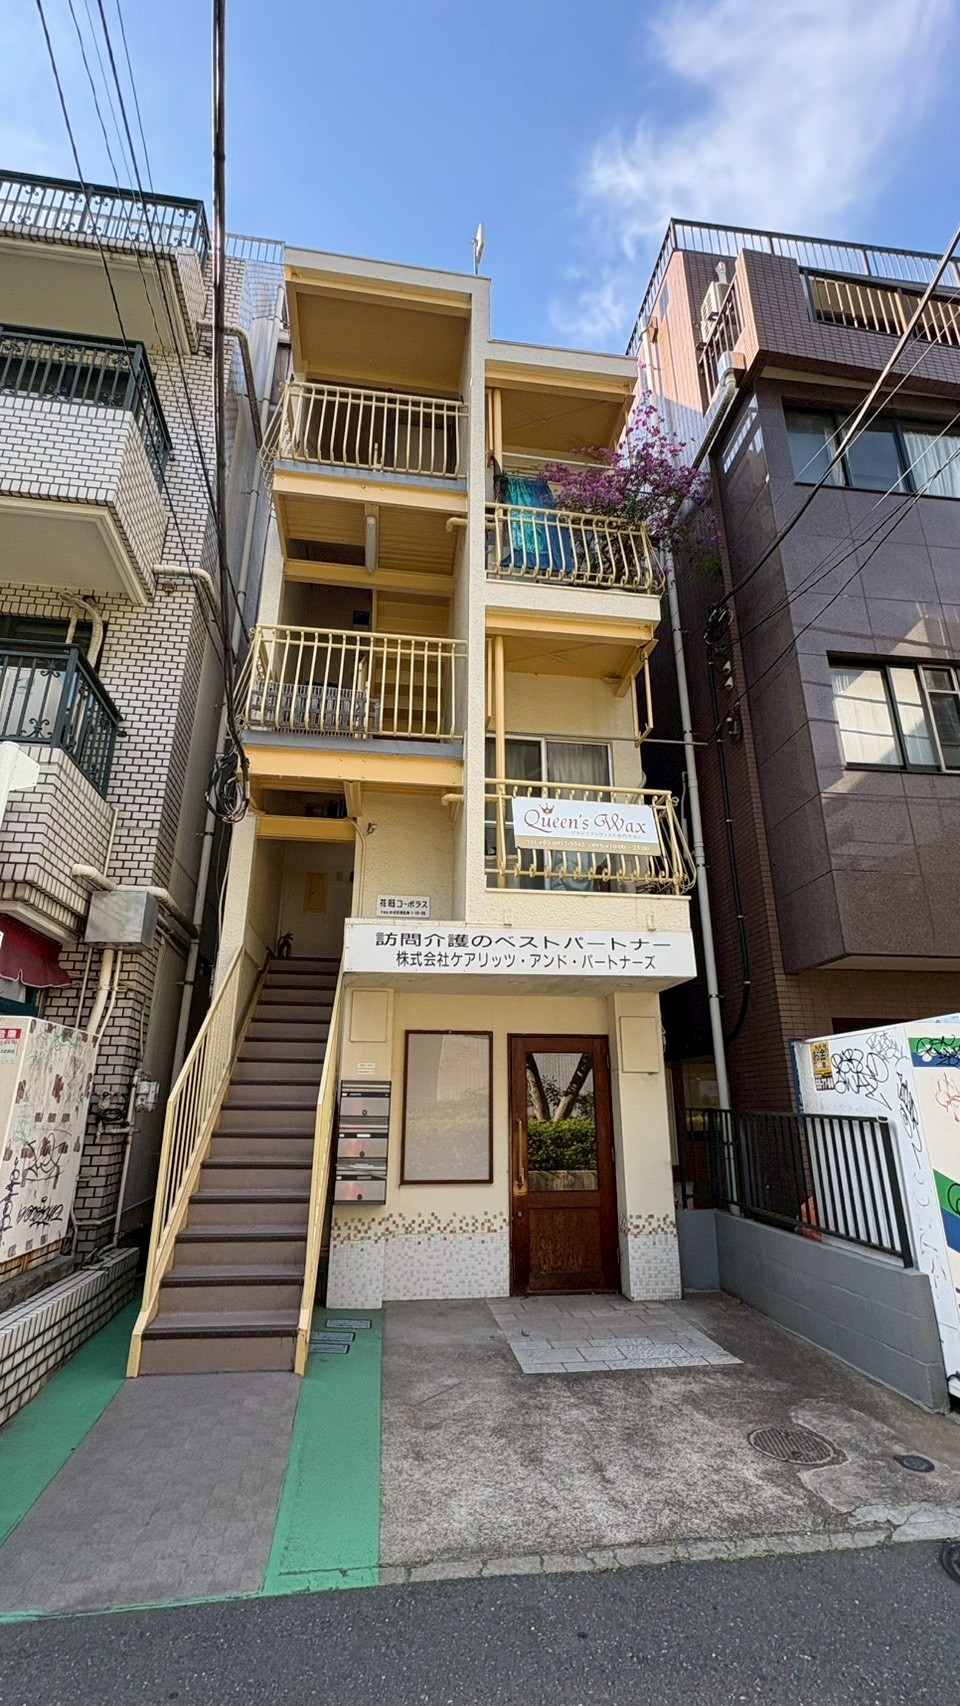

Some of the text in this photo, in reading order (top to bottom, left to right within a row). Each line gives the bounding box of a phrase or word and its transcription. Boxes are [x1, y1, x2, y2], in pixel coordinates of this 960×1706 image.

[524, 808, 646, 834] Queen's Wax
[375, 932, 671, 950] 訪問介護のベストパートナー
[395, 950, 656, 970] 株式会社ケアリッツ・アンド・パートナーズ
